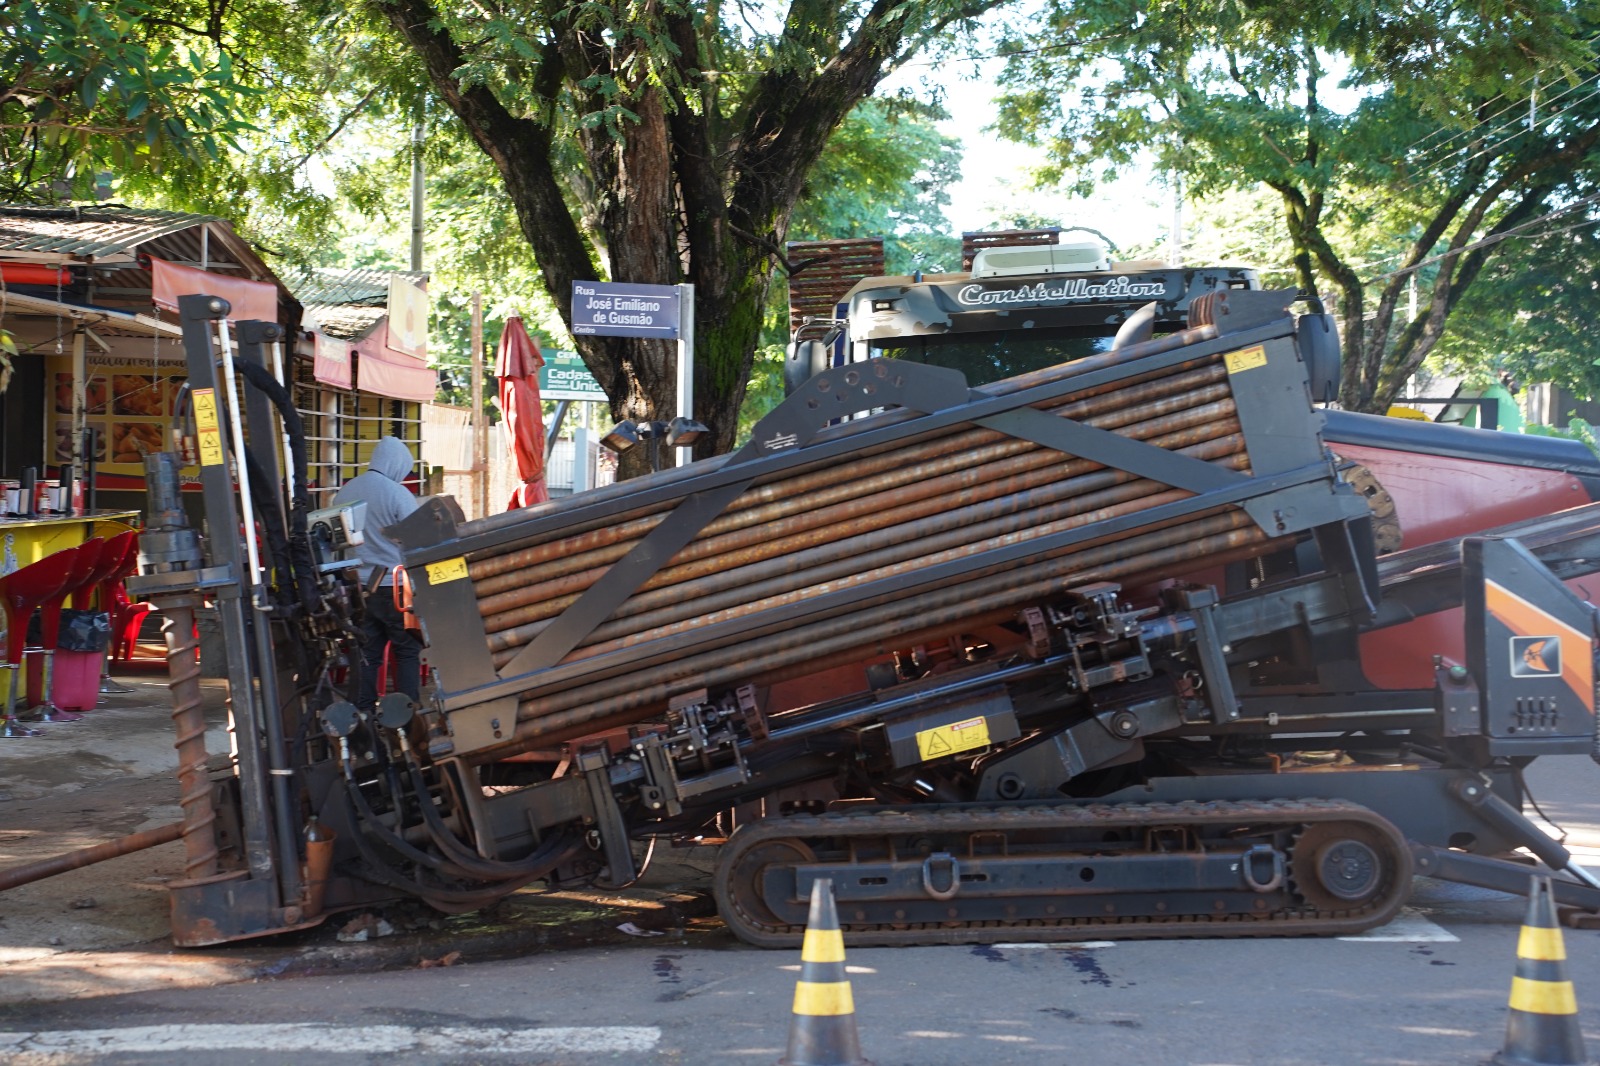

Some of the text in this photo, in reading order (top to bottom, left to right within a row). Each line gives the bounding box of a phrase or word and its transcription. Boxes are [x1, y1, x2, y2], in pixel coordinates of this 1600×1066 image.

[575, 286, 595, 295] Rua
[958, 276, 1166, 305] Constellation
[586, 297, 660, 312] José Emiliano
[592, 311, 653, 325] de Gusmão
[574, 326, 596, 334] Centro
[547, 368, 595, 380] Cadas
